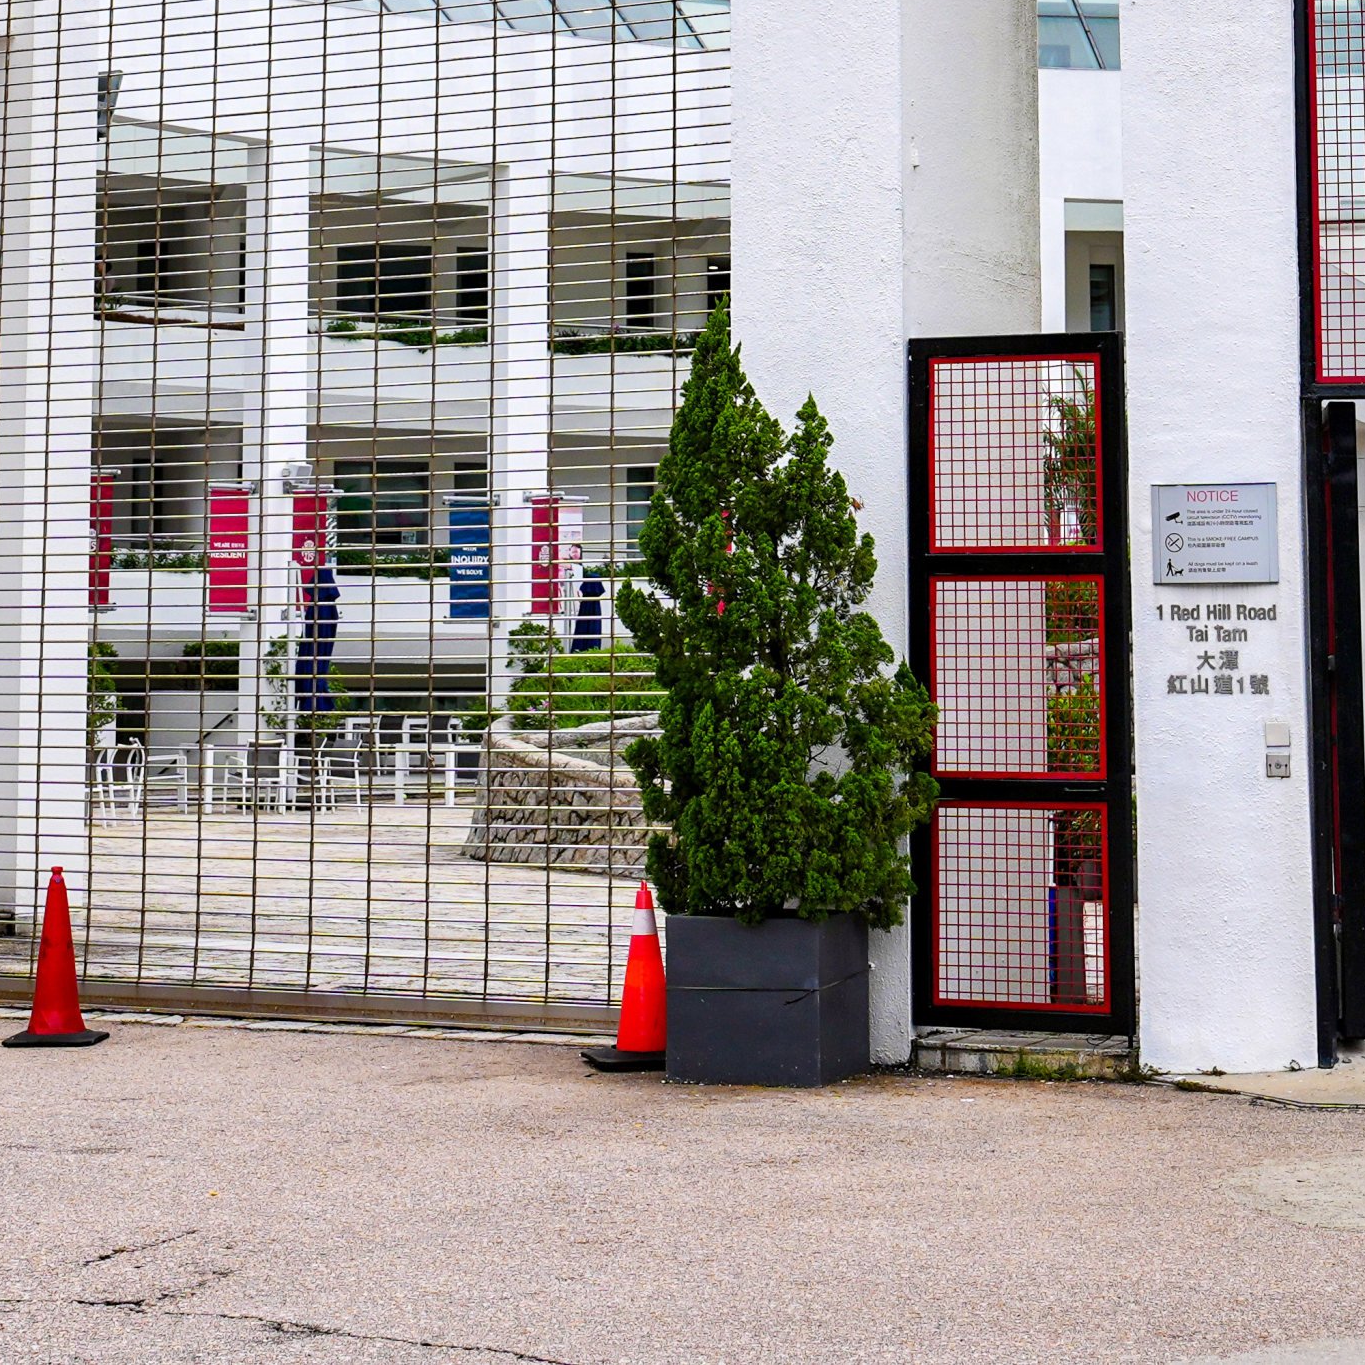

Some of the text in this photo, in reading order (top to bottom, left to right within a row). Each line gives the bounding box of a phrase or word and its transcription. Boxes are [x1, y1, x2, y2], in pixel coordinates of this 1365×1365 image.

[1186, 490, 1239, 502] NOTICE
[1156, 604, 1277, 621] 1 Red Hill Road
[1186, 624, 1248, 643] Tai Tam
[1196, 649, 1239, 671] 大潭
[1166, 674, 1270, 696] 紅山道1號
